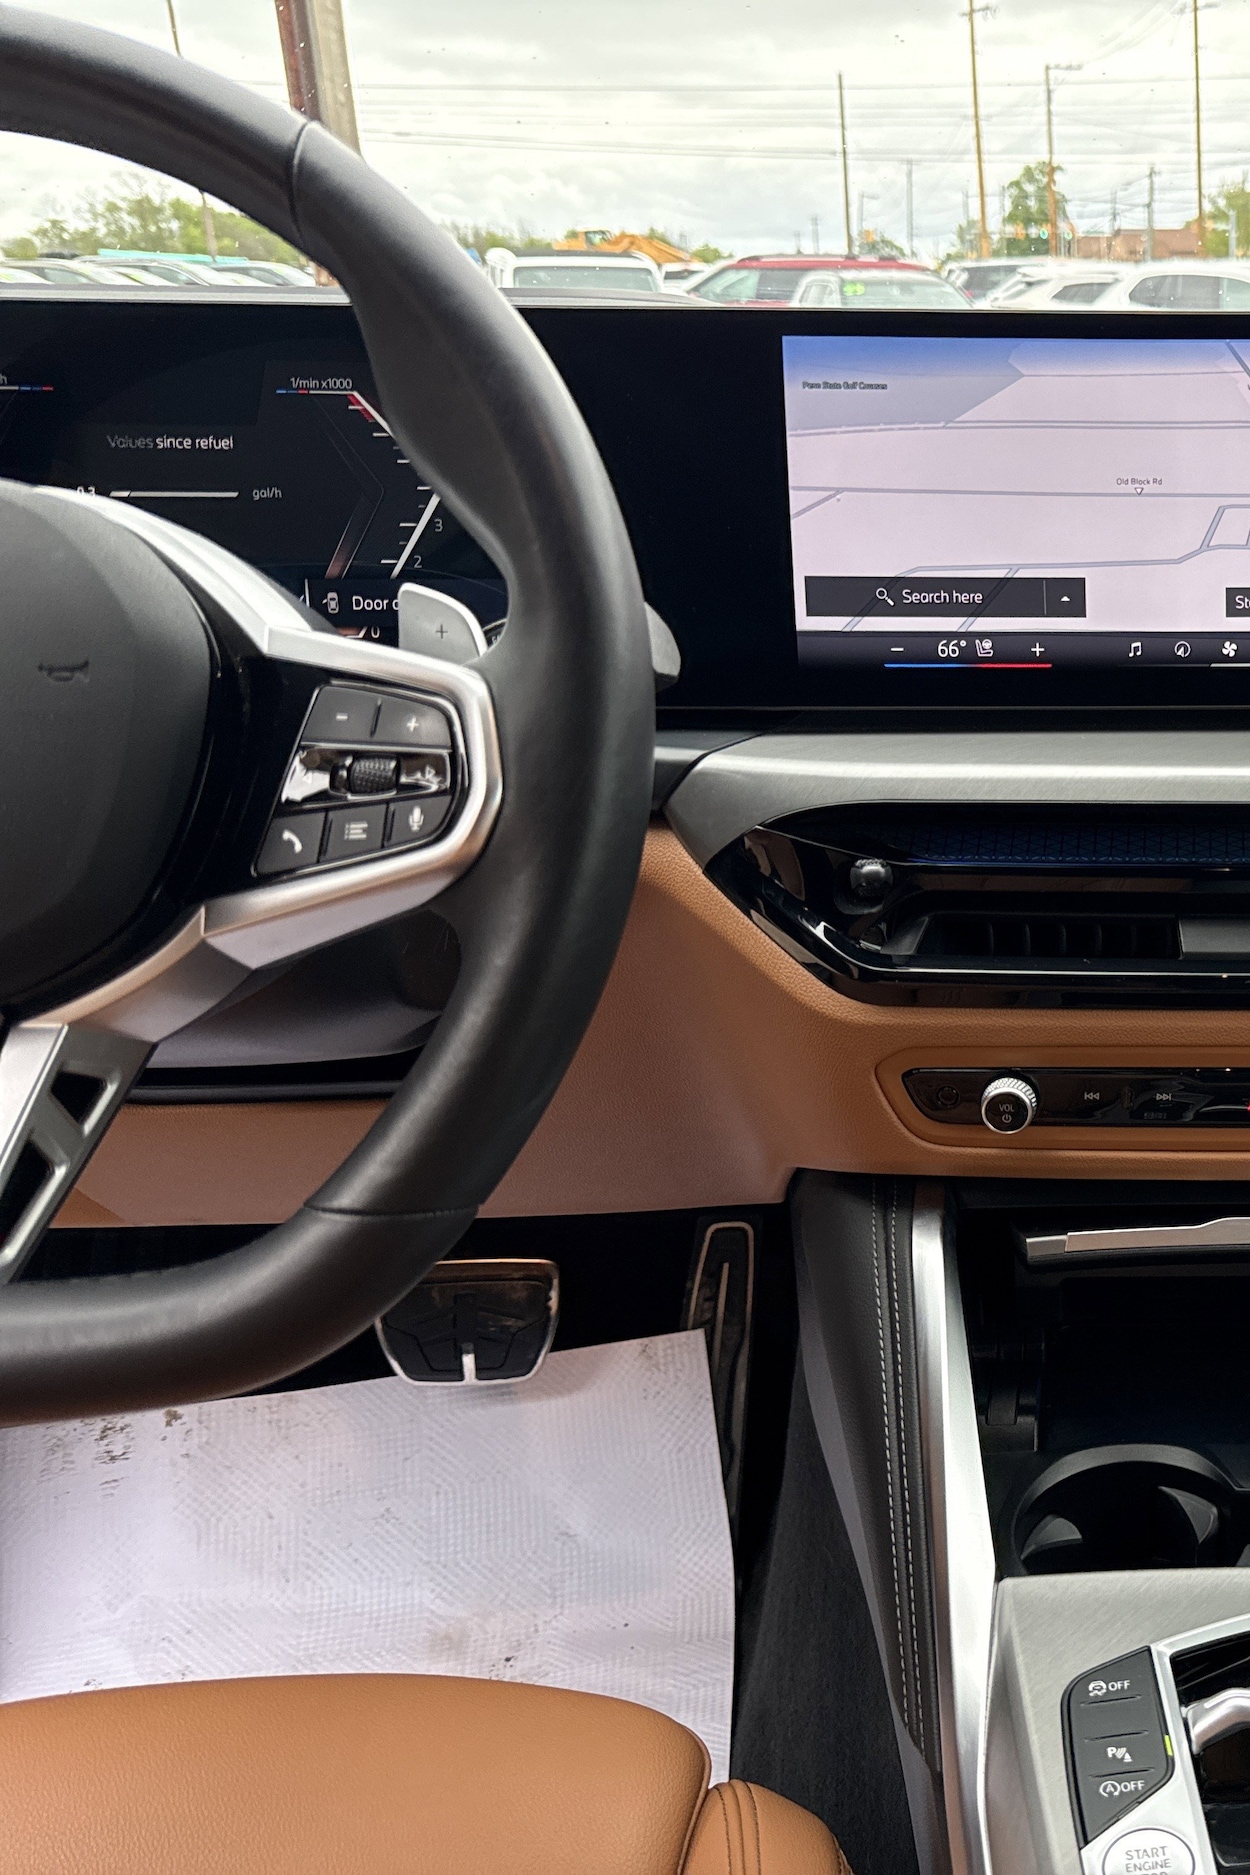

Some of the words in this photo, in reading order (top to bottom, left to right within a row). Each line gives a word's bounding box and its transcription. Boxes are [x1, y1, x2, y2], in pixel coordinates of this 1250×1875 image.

[290, 376, 320, 389] 1/min
[321, 378, 353, 389] x1000
[822, 381, 842, 389] State
[842, 381, 858, 389] Golf
[107, 435, 154, 449] Values
[155, 434, 192, 449] since
[195, 435, 234, 450] refuel
[1116, 477, 1129, 486] Old
[1130, 477, 1151, 486] Block
[1152, 477, 1163, 486] Rd
[252, 487, 283, 501] gal/h
[434, 518, 443, 532] 3
[413, 555, 423, 568] 2
[352, 595, 389, 611] Door
[902, 589, 949, 604] Search
[952, 589, 983, 604] here
[999, 1103, 1015, 1112] VOL
[1108, 1680, 1131, 1691] OFF
[1120, 1780, 1145, 1792] OFF
[1125, 1846, 1168, 1861] START
[1125, 1858, 1171, 1873] ENGINE
